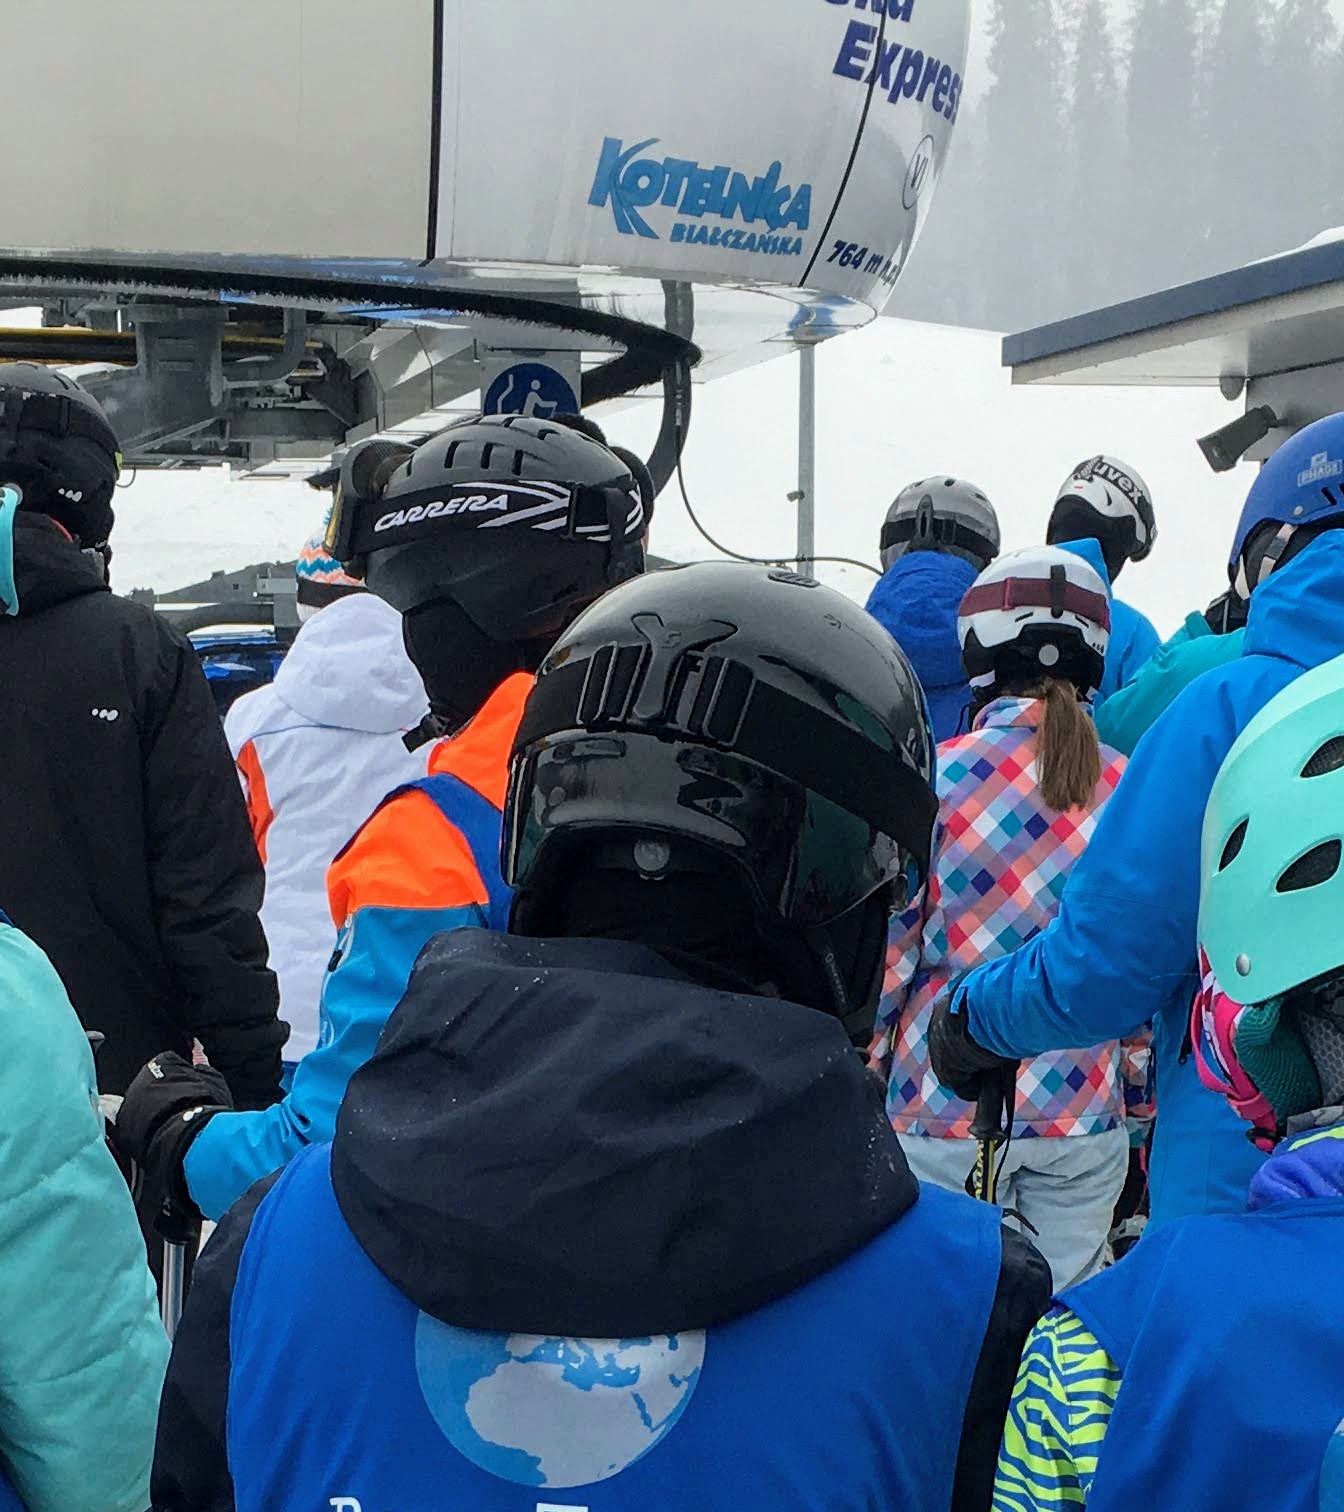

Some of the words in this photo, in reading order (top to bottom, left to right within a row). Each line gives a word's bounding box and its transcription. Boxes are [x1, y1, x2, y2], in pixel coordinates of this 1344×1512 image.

[827, 240, 869, 270] 764
[1092, 462, 1142, 504] uvex
[375, 494, 508, 532] CARRERA
